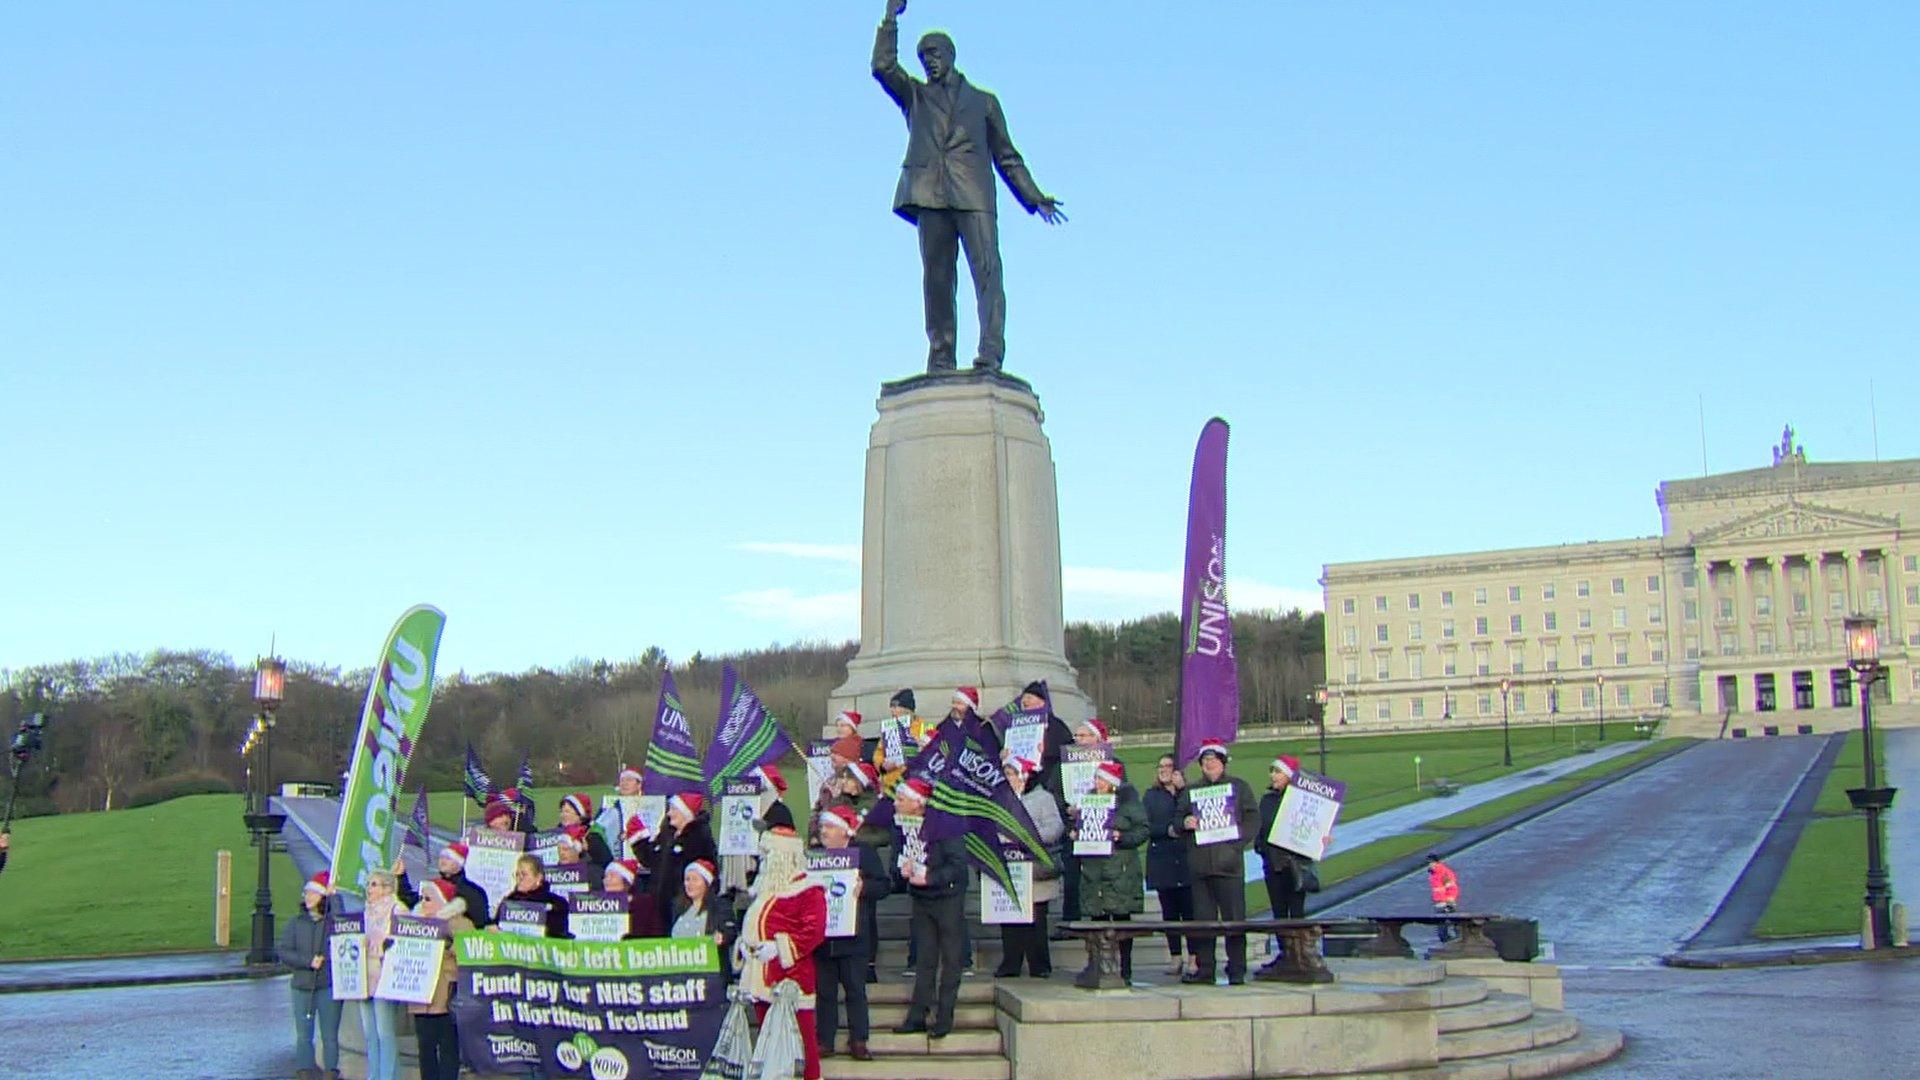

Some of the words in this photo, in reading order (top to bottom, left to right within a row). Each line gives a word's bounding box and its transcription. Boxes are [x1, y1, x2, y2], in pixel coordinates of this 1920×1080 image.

[1297, 777, 1336, 798] UNISON
[1200, 814, 1231, 831] NOW
[477, 835, 516, 849] UNISON
[1079, 829, 1109, 841] NOW
[807, 856, 850, 869] UNISON
[576, 899, 620, 911] UNISON
[505, 910, 540, 922] UNISON
[335, 920, 361, 932] UNISON
[397, 923, 439, 938] UNISON
[463, 936, 494, 960] We
[501, 939, 548, 965] won't
[552, 942, 579, 969] be
[583, 945, 622, 970] left
[628, 943, 708, 970] behind
[472, 972, 522, 996] Fund
[525, 979, 559, 1003] pay
[562, 980, 591, 1004] for
[595, 982, 643, 1006] NHS
[649, 977, 706, 1005] staff
[516, 1002, 602, 1031] Northern
[606, 1008, 689, 1031] Ireland
[491, 1039, 538, 1056] UNISON
[648, 1048, 697, 1061] UNISON
[594, 1056, 625, 1075] NOW!
